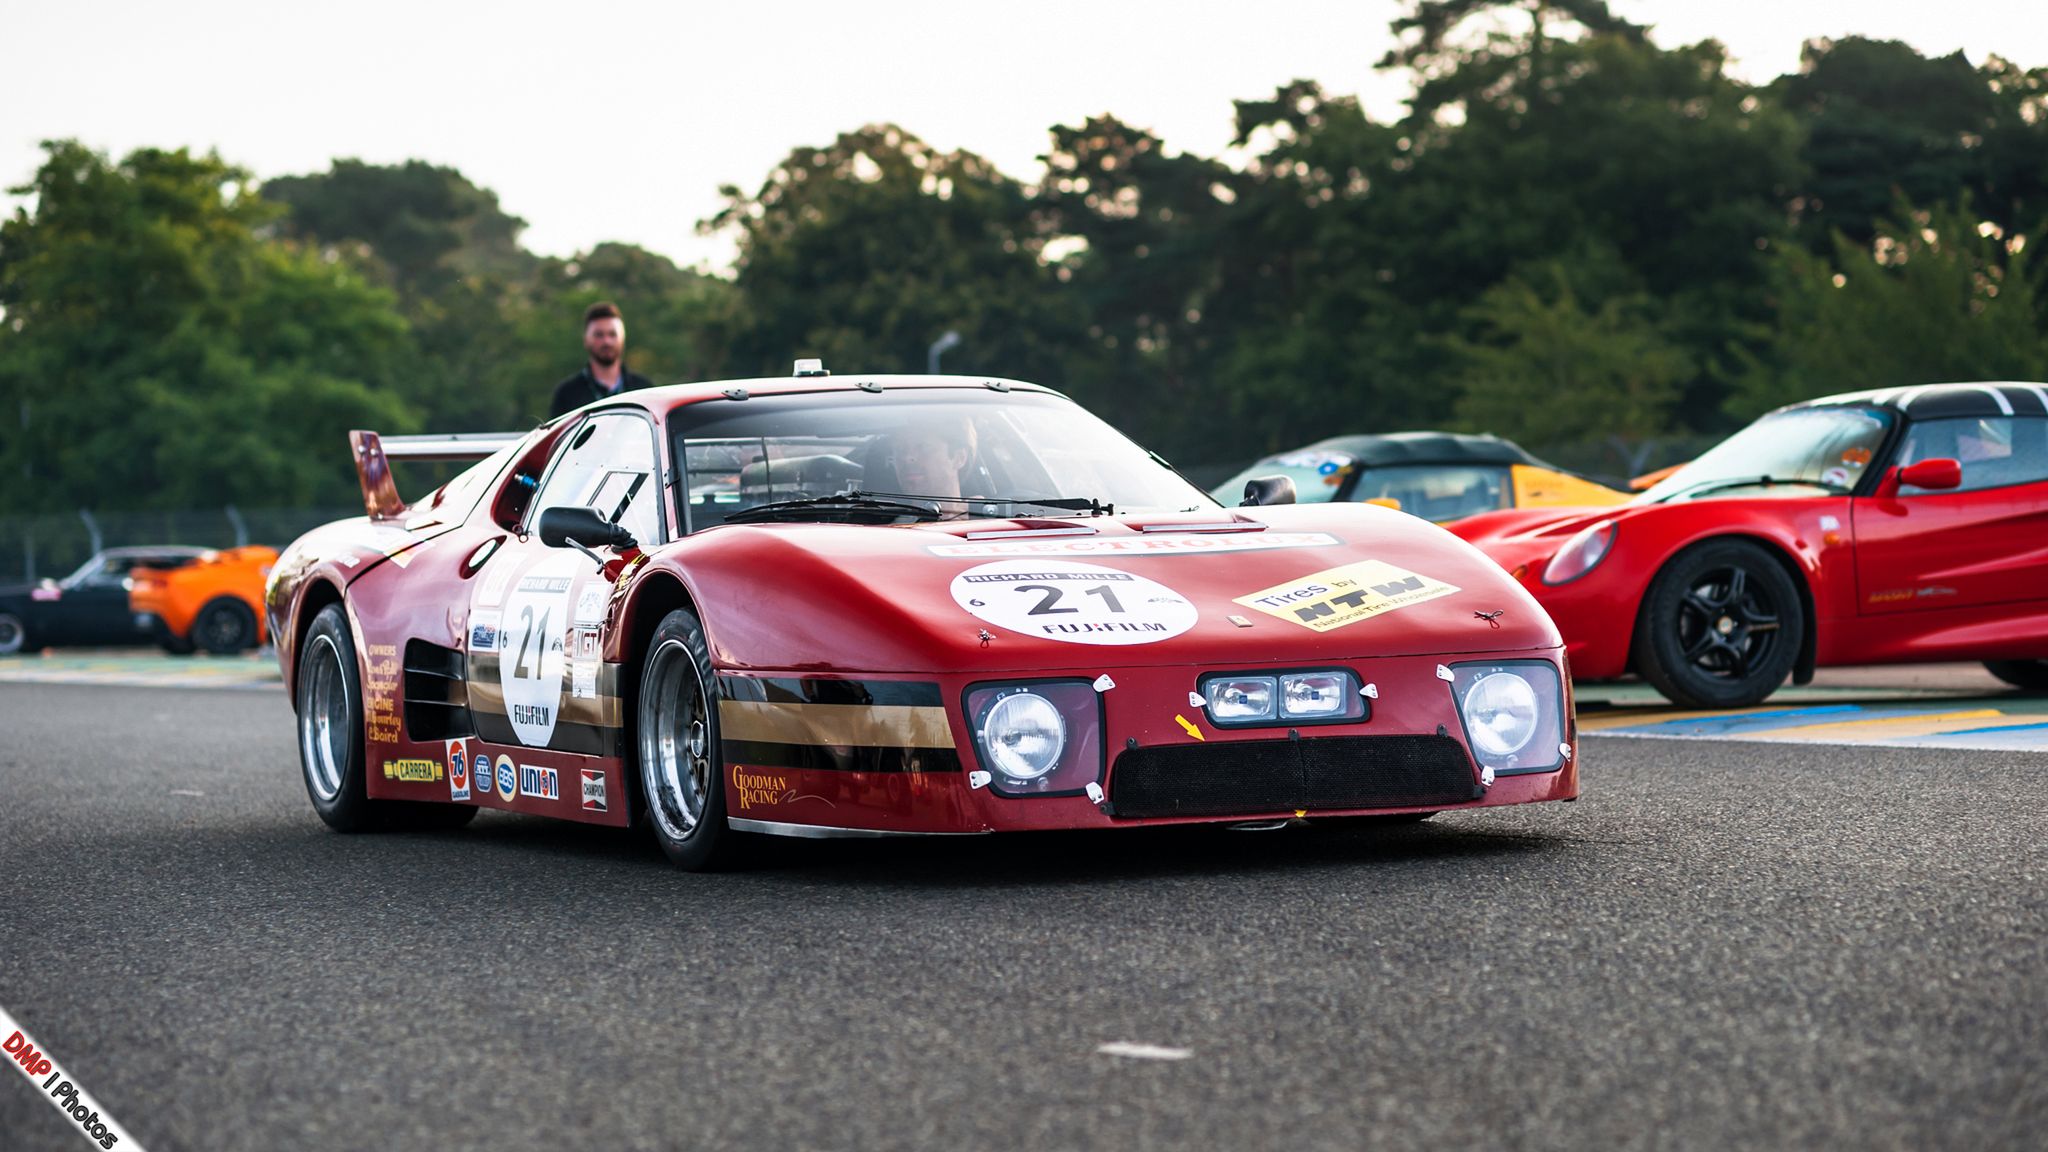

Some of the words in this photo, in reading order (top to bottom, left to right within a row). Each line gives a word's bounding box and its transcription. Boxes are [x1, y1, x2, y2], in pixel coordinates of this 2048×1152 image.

[948, 533, 1328, 555] ELECTROLUX
[969, 573, 1059, 582] RICHARD
[1067, 573, 1129, 581] MILLE
[969, 598, 986, 607] 6
[1013, 585, 1126, 615] 21
[1254, 584, 1329, 607] Tires
[1331, 578, 1358, 588] by
[1294, 576, 1426, 622] NTW
[1313, 608, 1364, 628] National
[1364, 600, 1389, 613] Tire
[1042, 622, 1168, 634] FUJIFILM
[368, 644, 397, 656] OWNERS
[502, 631, 508, 649] 6
[514, 605, 551, 680] 21
[514, 704, 550, 727] FUJIFILM
[400, 762, 433, 779] CARRERA
[451, 749, 465, 778] 76
[499, 767, 514, 789] BBS
[732, 765, 786, 791] GOODMAN
[583, 783, 605, 797] CHAMPION
[740, 788, 778, 810] RACING
